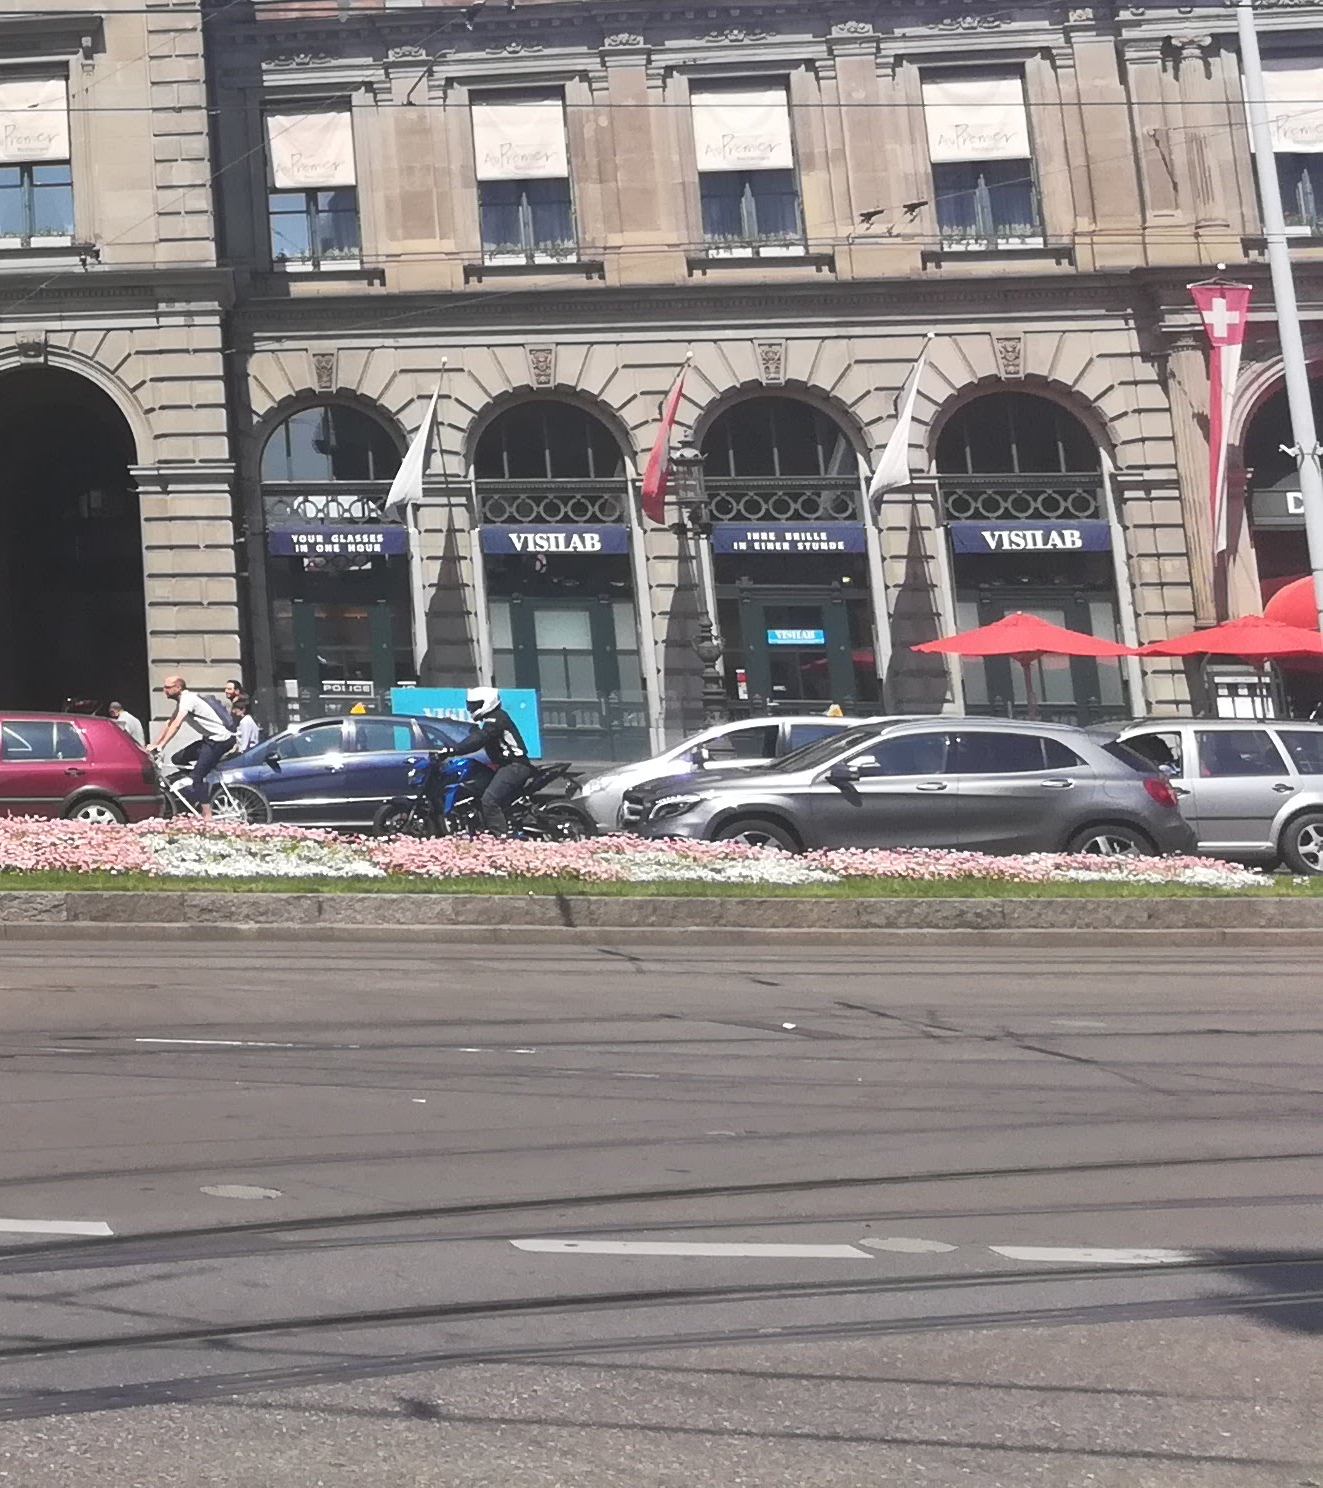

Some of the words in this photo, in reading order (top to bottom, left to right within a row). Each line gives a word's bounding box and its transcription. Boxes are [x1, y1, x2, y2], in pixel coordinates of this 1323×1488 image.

[1286, 491, 1305, 514] D
[290, 534, 324, 544] YOUR
[331, 533, 384, 543] GLASSES
[508, 532, 602, 552] VISILAB
[797, 541, 845, 551] STUNDE
[981, 529, 1084, 550] VISILAB
[295, 544, 309, 553] IN
[315, 544, 341, 553] ONE
[347, 544, 382, 553] HOUR
